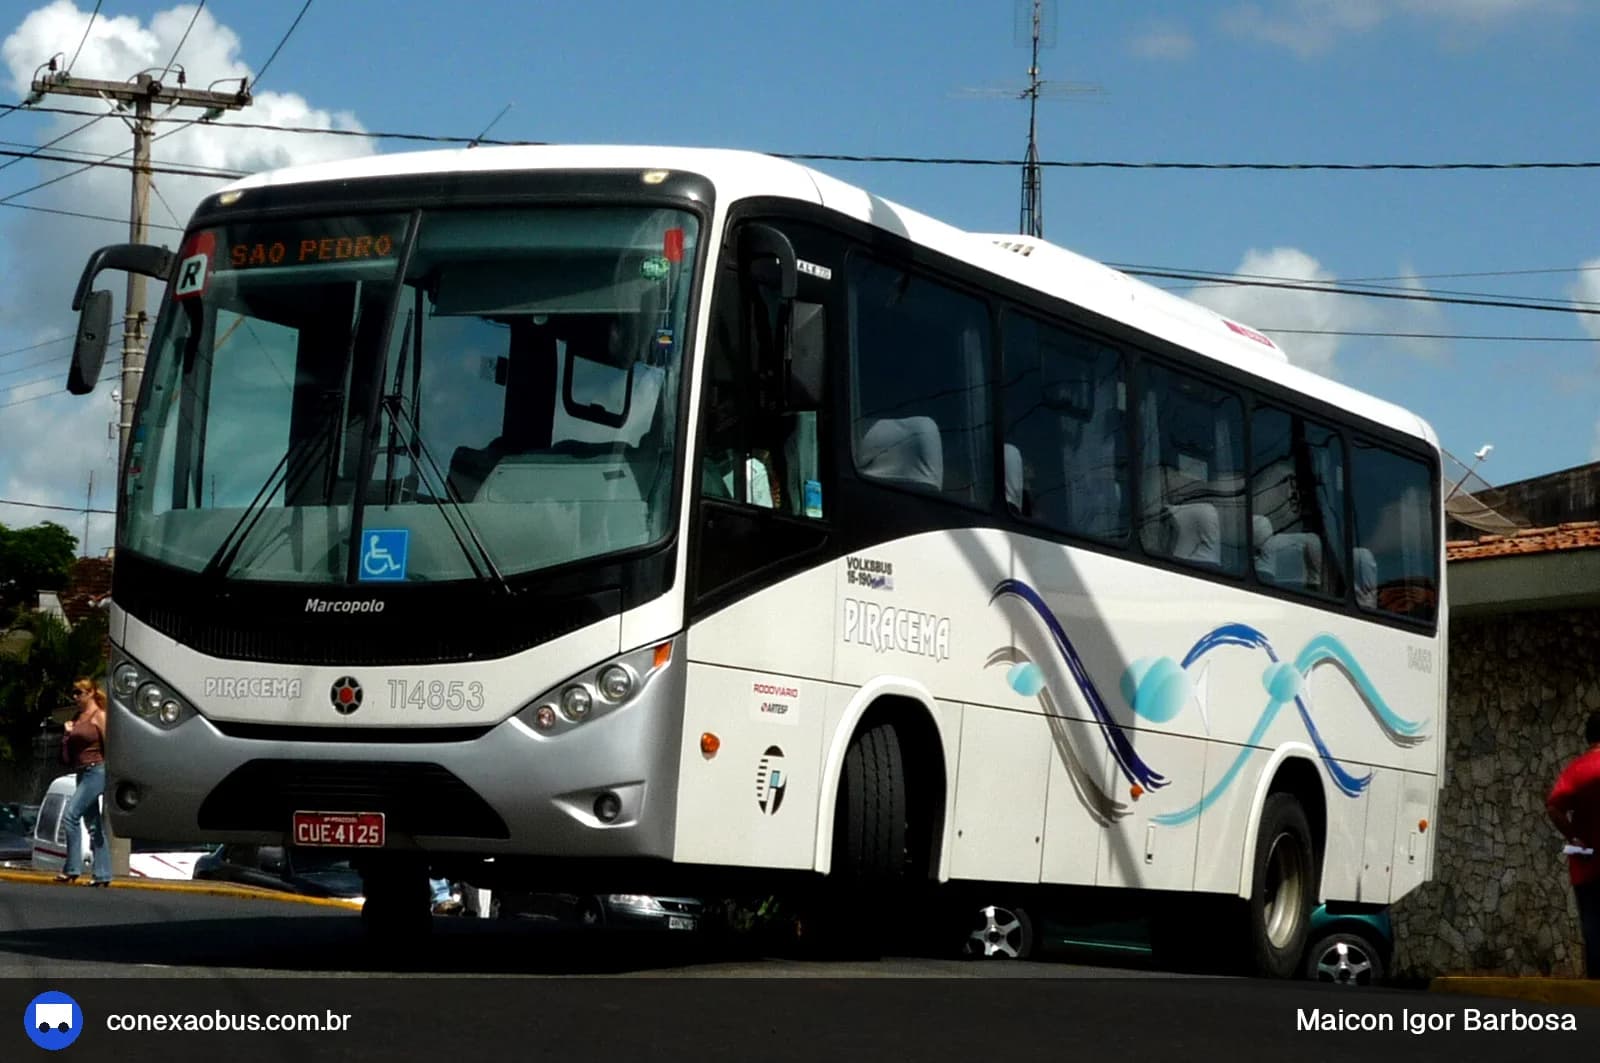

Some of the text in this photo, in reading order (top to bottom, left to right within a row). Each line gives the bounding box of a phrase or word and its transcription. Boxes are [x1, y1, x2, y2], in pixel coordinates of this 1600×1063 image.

[231, 234, 393, 266] SAO PEDRO
[180, 263, 202, 290] R
[846, 556, 893, 576] VOLKSBUS
[304, 598, 386, 614] Marcopolo
[843, 597, 951, 663] PIRACEMA
[204, 677, 303, 700] PIRACEMA
[387, 678, 485, 712] 114853
